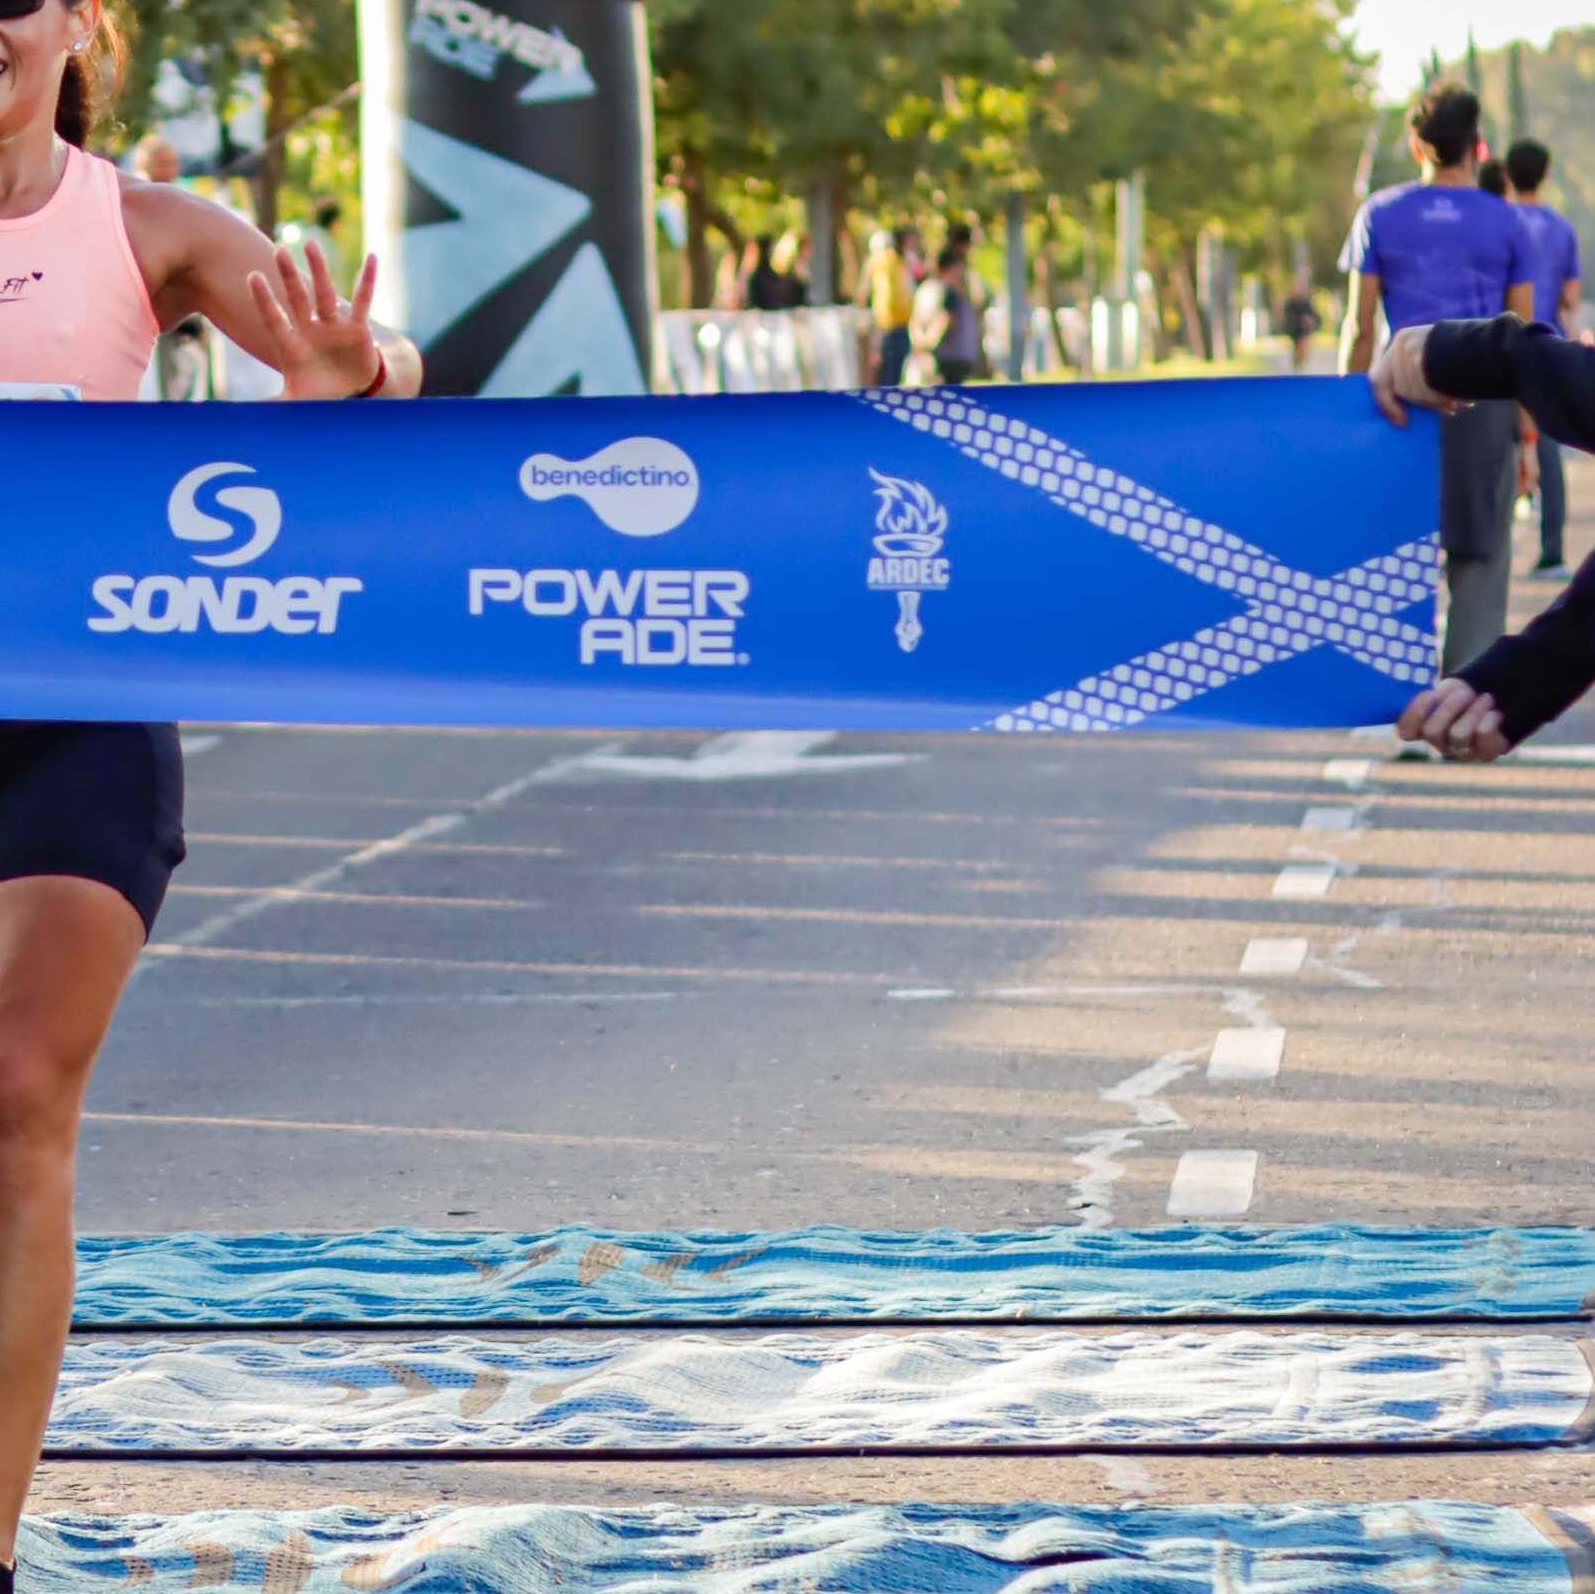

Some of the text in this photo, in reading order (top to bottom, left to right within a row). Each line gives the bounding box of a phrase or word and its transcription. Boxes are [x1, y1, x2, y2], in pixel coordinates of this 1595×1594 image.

[531, 464, 691, 487] benedictino
[867, 557, 950, 584] ARDEC
[468, 568, 750, 617] POWER
